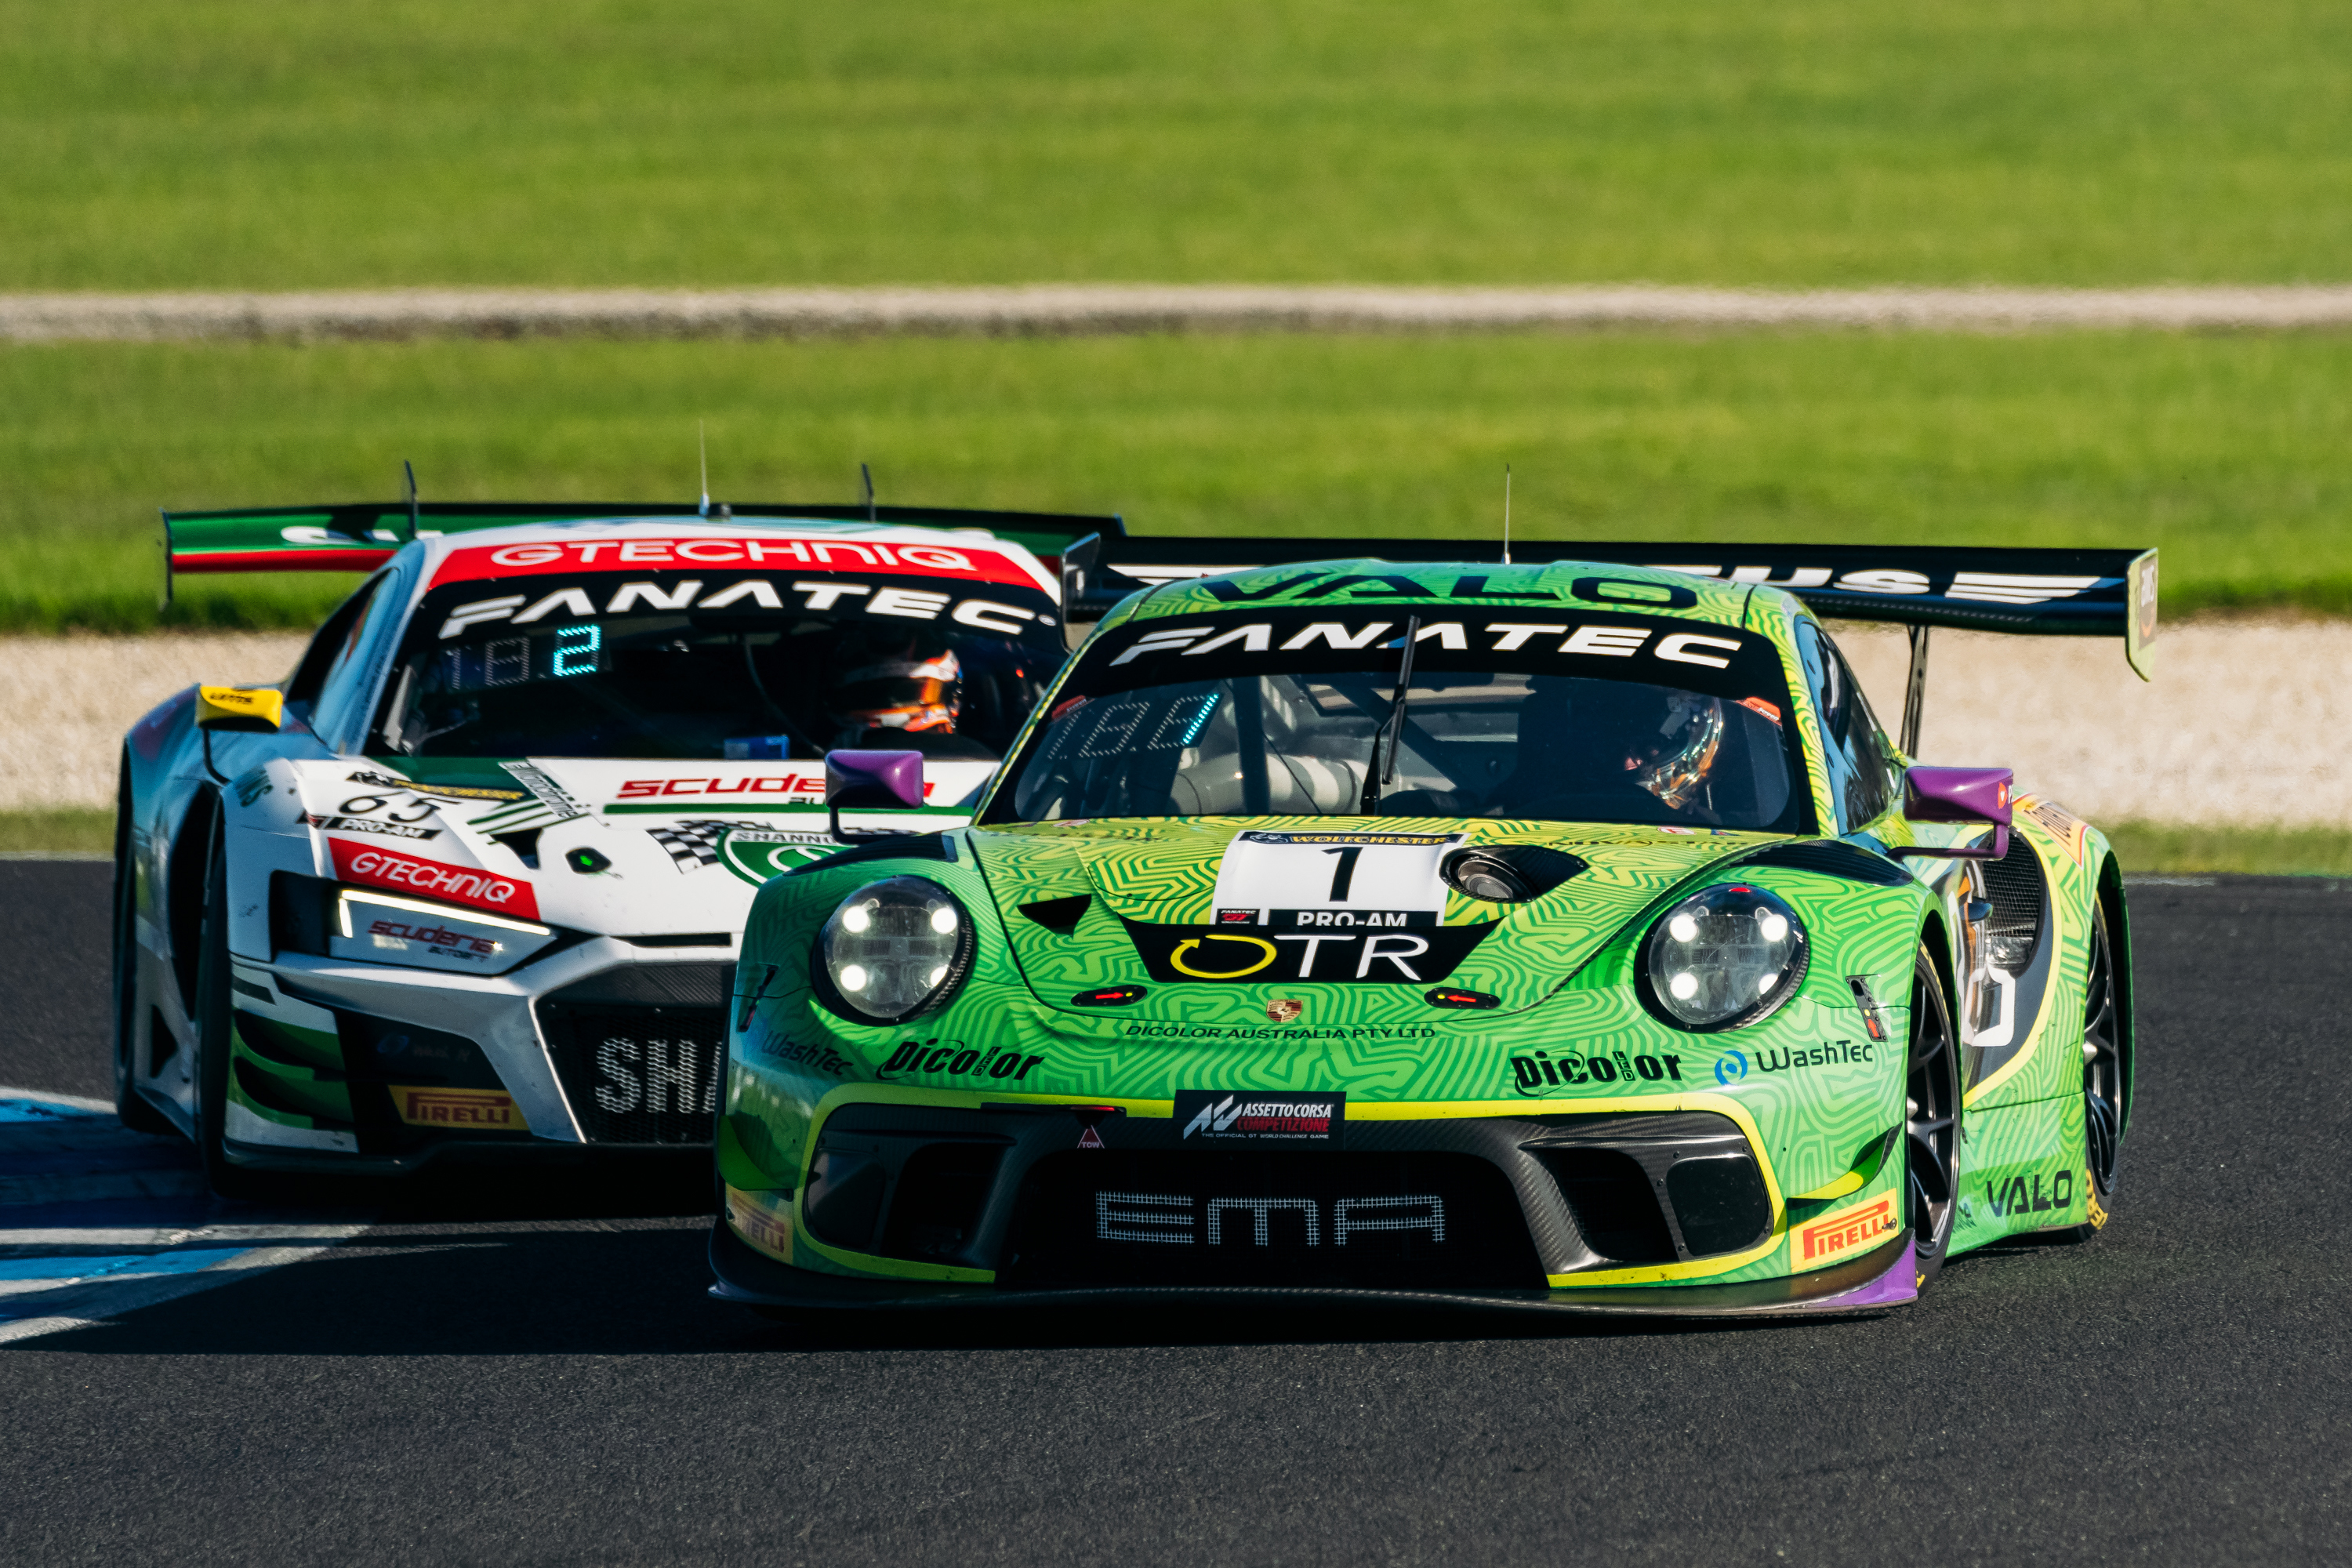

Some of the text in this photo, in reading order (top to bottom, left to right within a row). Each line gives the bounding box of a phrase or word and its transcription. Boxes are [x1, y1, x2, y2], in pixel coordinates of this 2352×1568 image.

[490, 539, 978, 571] GTECHNIQ
[1199, 572, 1697, 609] VALO
[438, 579, 1036, 639] FANATEC
[1108, 622, 1742, 669] FANATEC
[339, 791, 462, 823] 65
[339, 818, 426, 840] PRO-AM
[1292, 836, 1447, 845] WOLFCHESTER
[350, 851, 516, 903] GTECHNIQ
[1321, 846, 1364, 902] 1
[1297, 912, 1407, 927] PRO-AM
[1170, 934, 1429, 981] OTR
[1125, 1025, 1436, 1040] DICOLOR AUSTRALIA PTY LTD
[406, 1091, 512, 1123] PIRELLI
[1242, 1103, 1331, 1119] ASSETTO CORSA
[1236, 1116, 1331, 1133] COMPETIZIONE
[1987, 1169, 2073, 1218] VALO
[1802, 1200, 1889, 1261] PIRELLI
